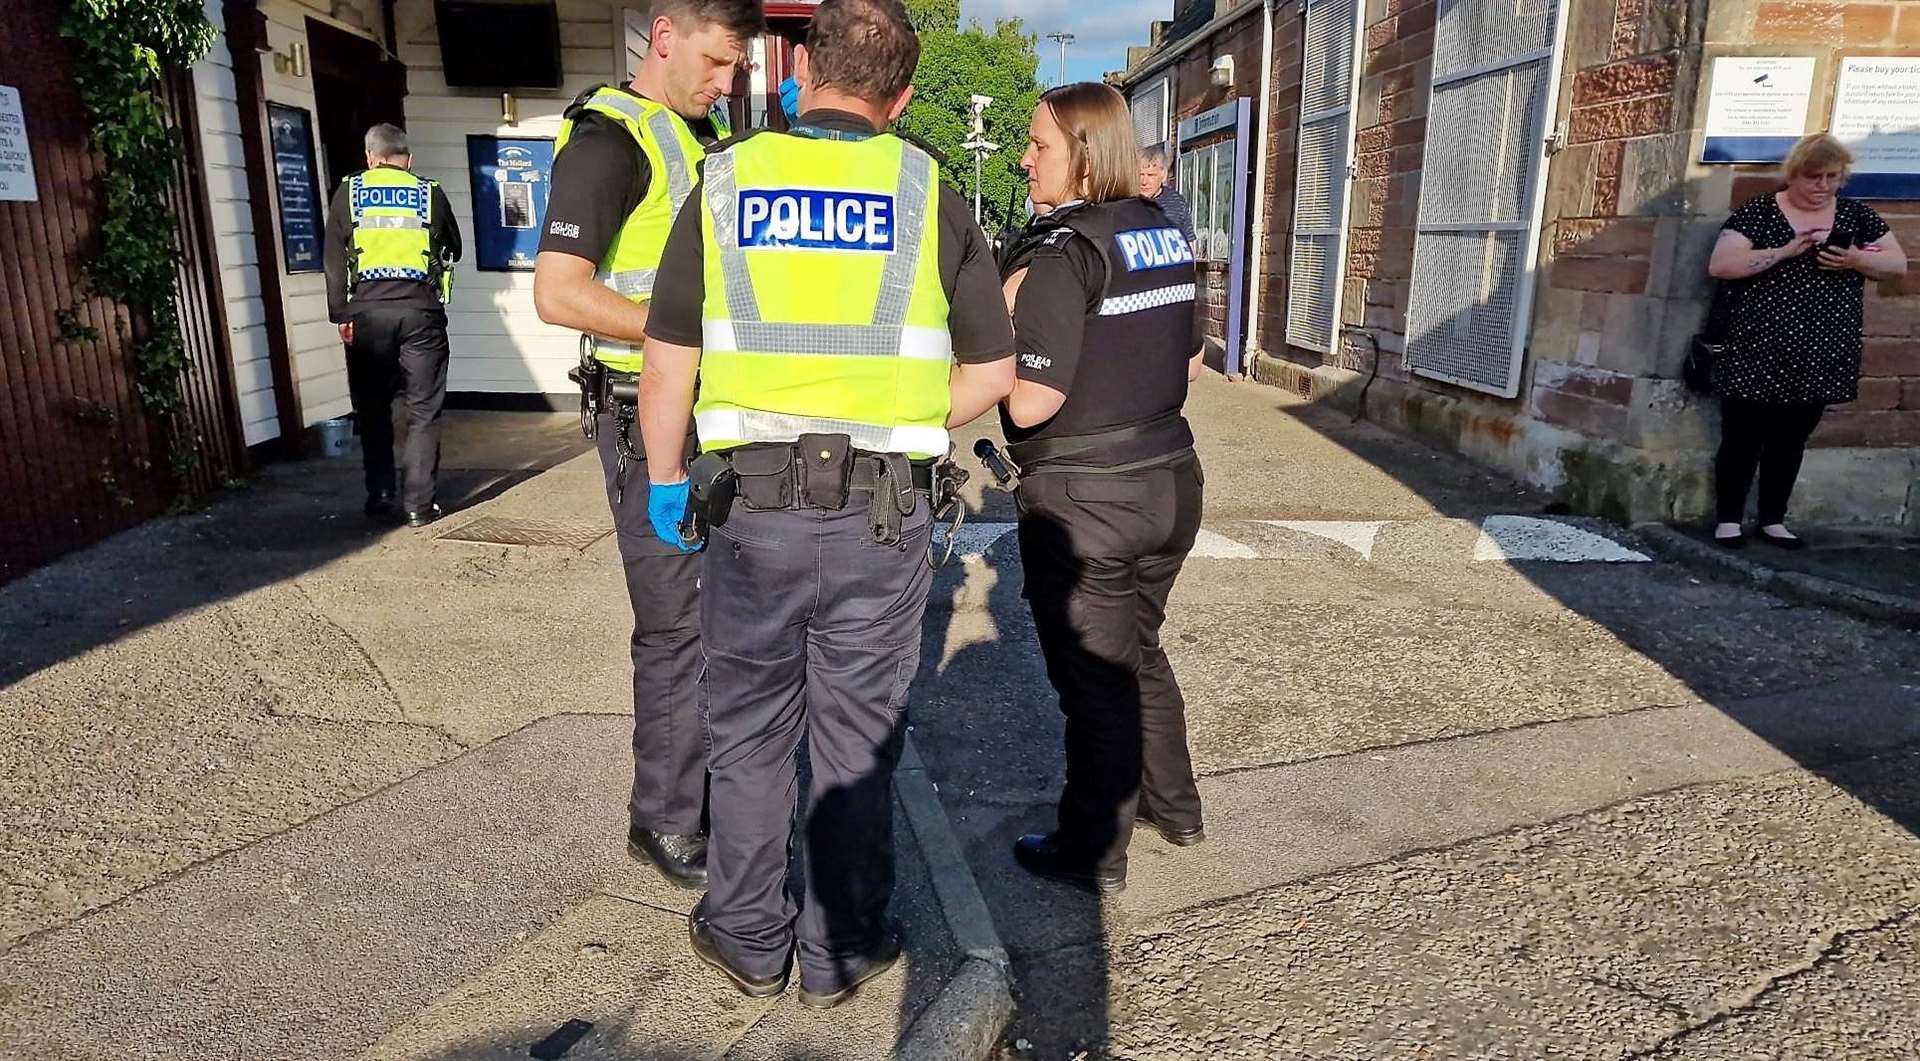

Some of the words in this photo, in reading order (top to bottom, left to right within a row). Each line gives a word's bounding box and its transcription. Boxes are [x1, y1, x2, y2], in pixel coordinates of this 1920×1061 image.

[1848, 64, 1873, 73] Please
[1875, 65, 1888, 75] buy
[1890, 66, 1908, 75] your
[360, 188, 418, 206] POLICE
[743, 196, 889, 243] POLICE
[1120, 228, 1193, 269] POLICE
